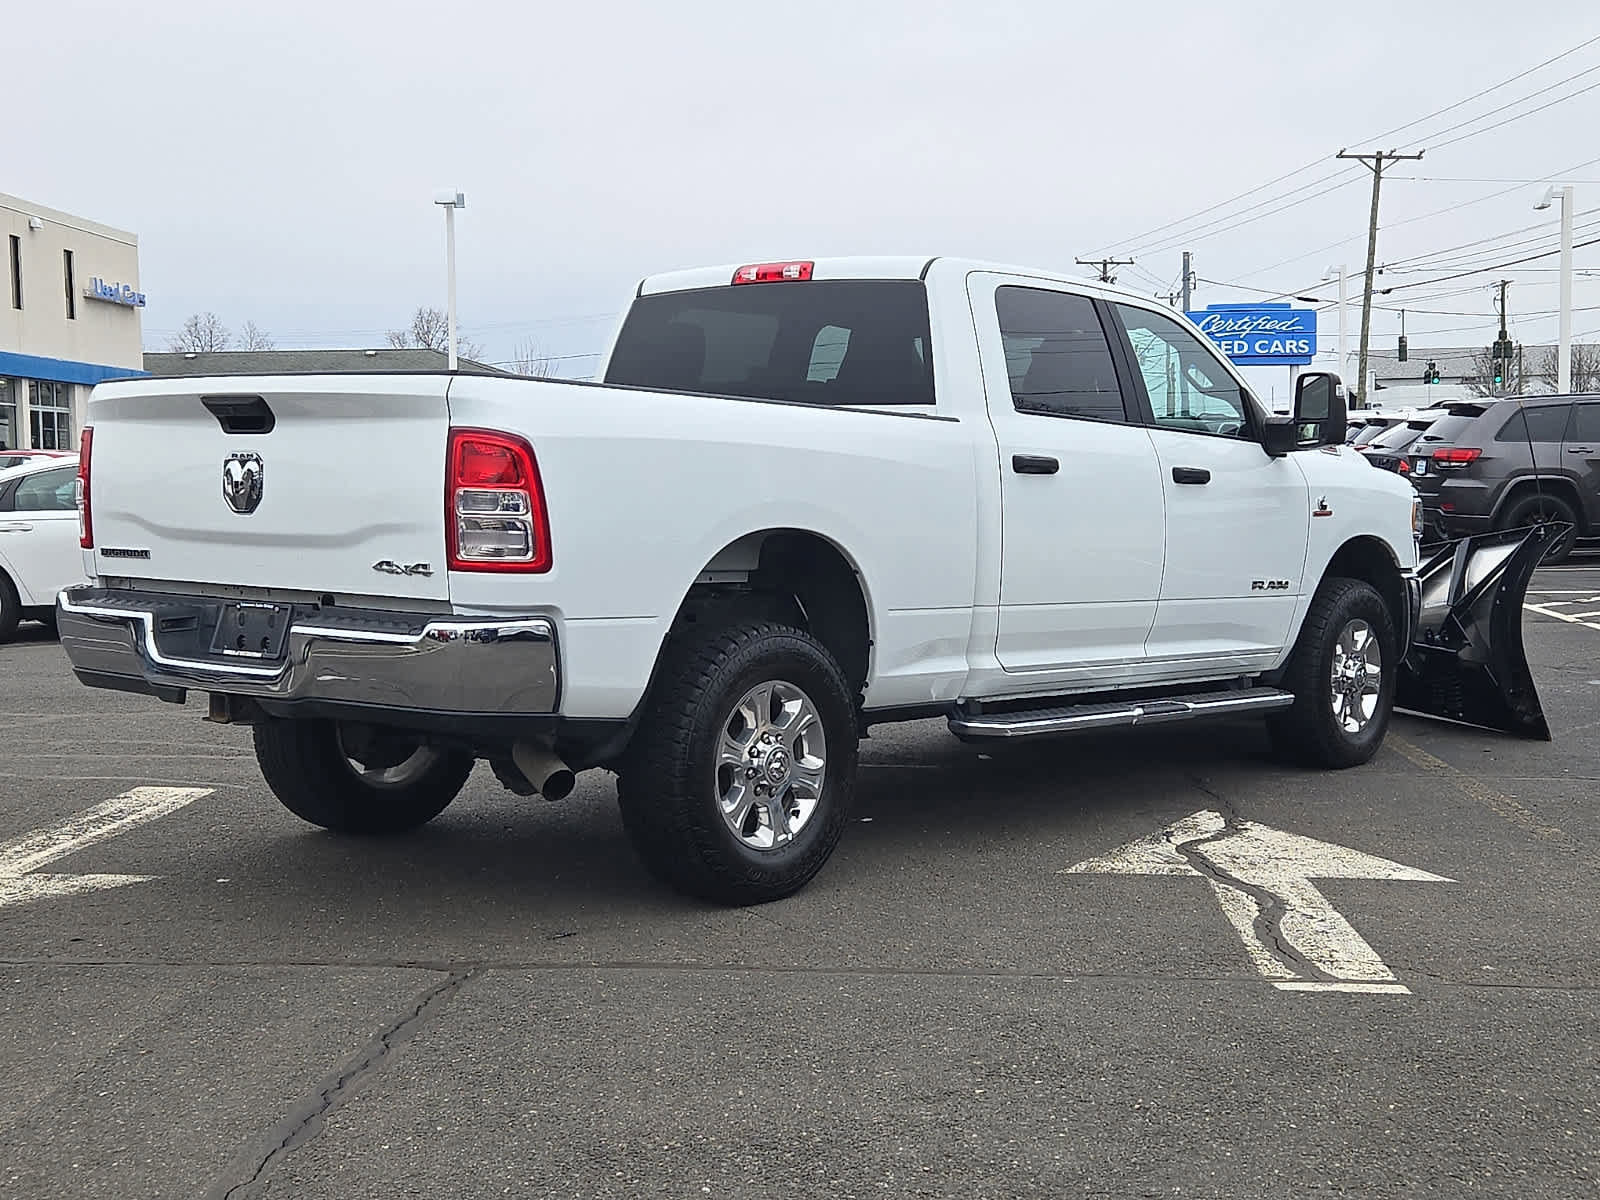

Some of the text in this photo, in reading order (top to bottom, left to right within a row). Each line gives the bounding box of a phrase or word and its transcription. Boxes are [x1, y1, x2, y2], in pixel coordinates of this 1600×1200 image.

[92, 277, 146, 307] Used Cars
[1200, 314, 1304, 338] Certified
[1213, 339, 1310, 354] ED CARS
[1251, 580, 1289, 590] RAM
